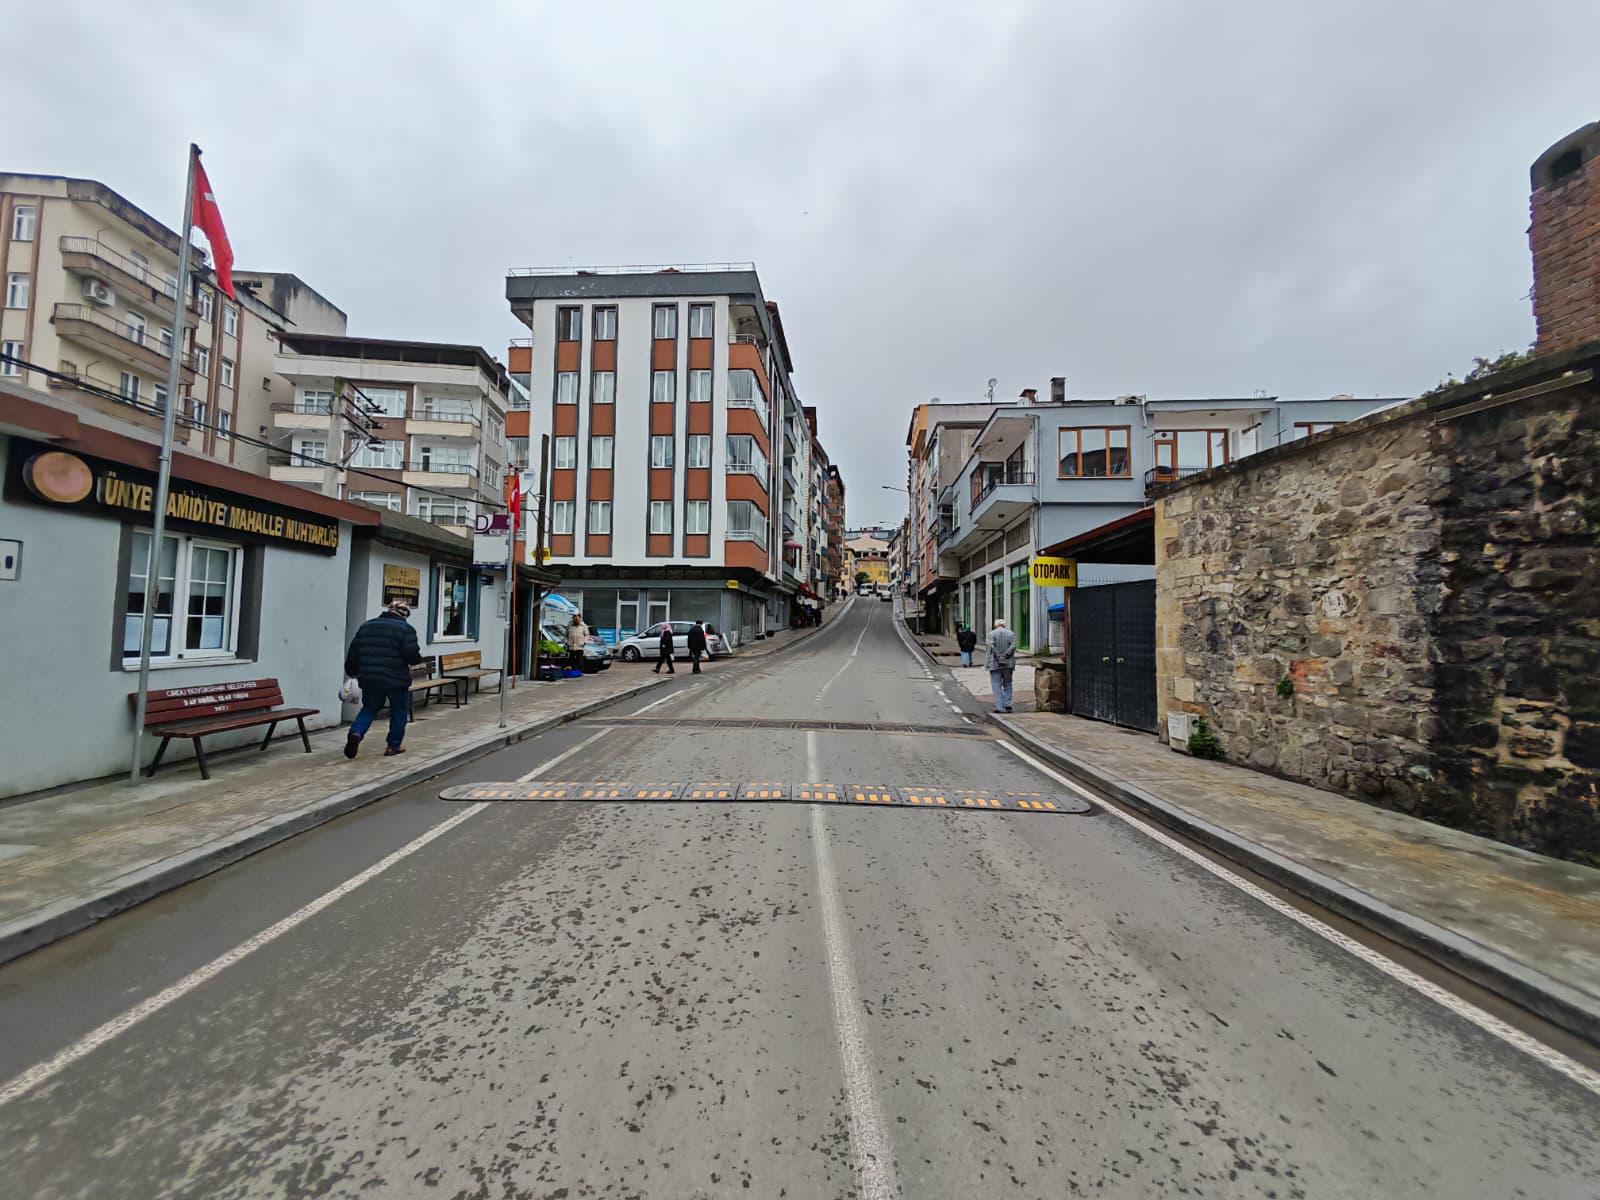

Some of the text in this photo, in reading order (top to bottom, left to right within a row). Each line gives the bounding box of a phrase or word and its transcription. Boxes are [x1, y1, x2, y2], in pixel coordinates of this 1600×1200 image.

[105, 471, 153, 511] ÜNYE
[165, 489, 227, 526] AMİDİYE
[229, 506, 284, 537] MAHALLE
[1033, 563, 1071, 580] OTOPARK
